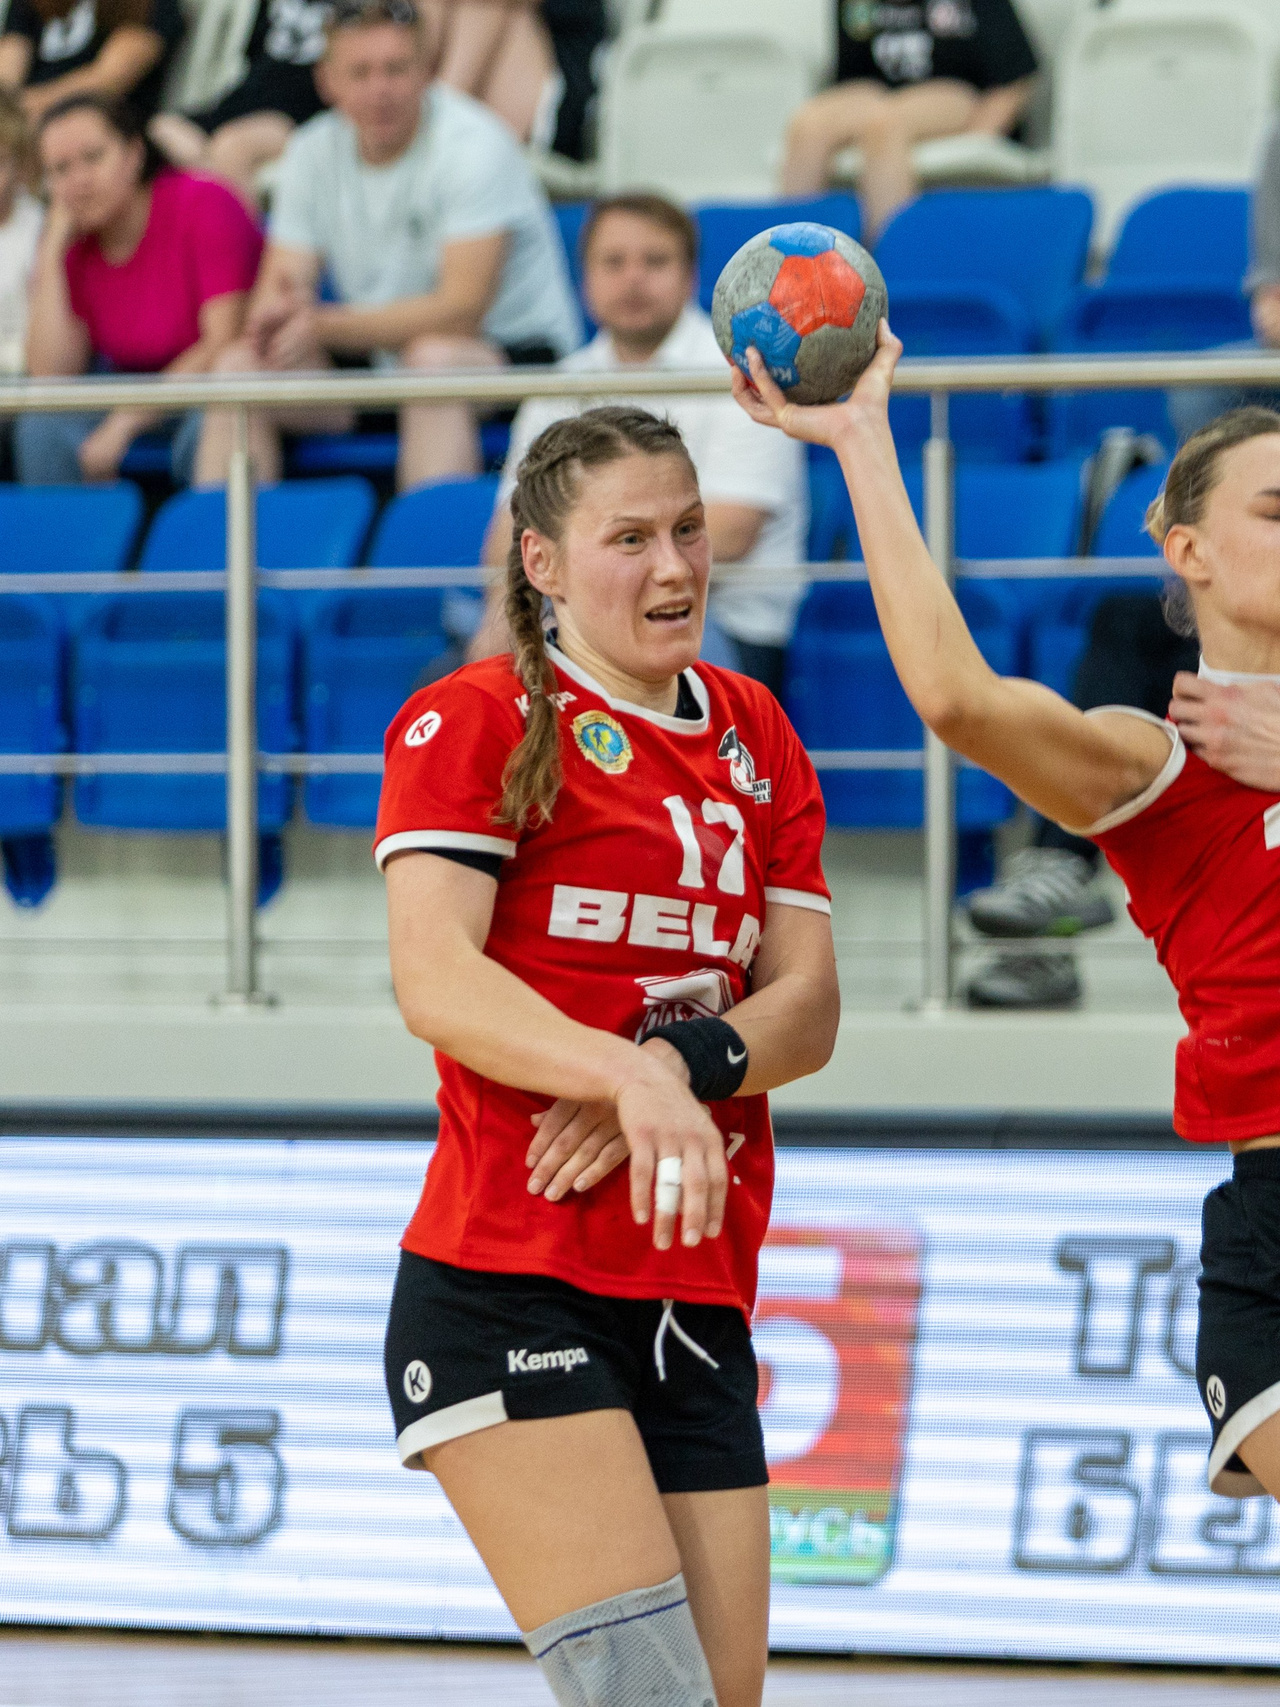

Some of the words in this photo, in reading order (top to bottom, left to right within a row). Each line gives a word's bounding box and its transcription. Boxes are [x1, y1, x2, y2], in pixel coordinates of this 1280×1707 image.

[662, 794, 745, 896] 17
[507, 1347, 589, 1373] Kempa
[169, 1405, 283, 1548] 5
